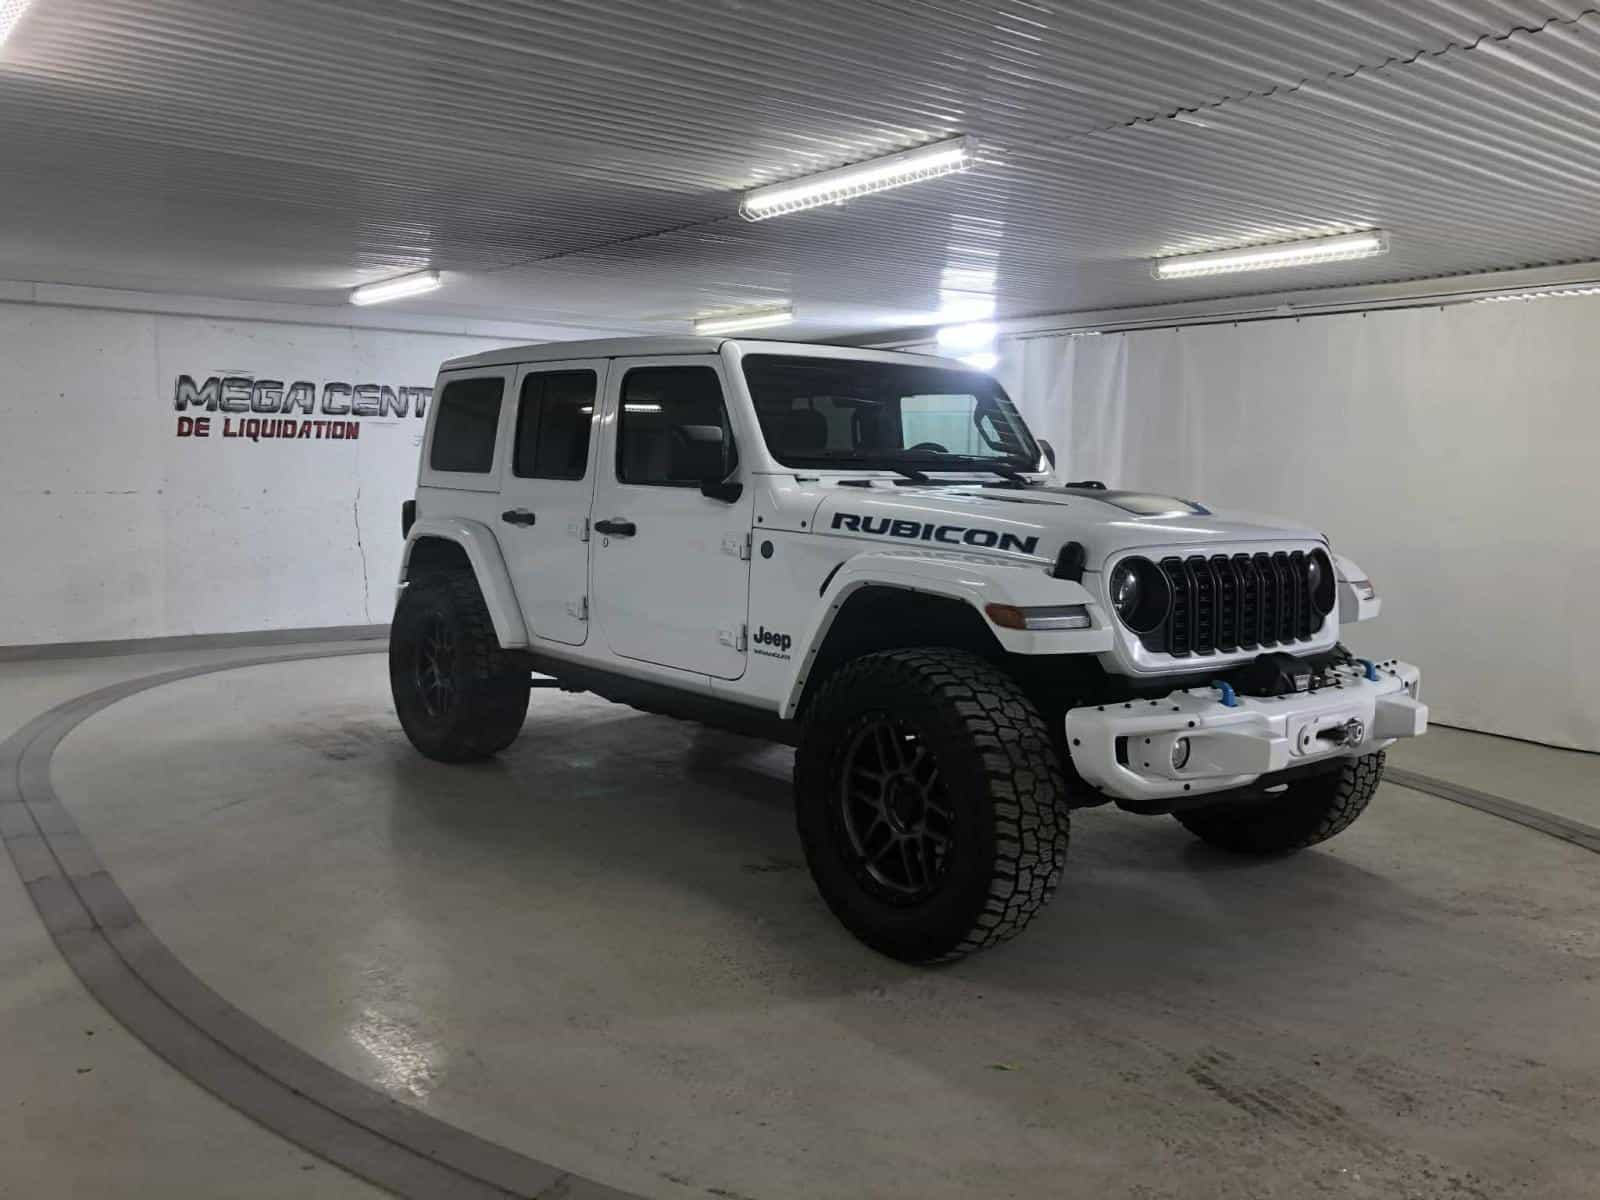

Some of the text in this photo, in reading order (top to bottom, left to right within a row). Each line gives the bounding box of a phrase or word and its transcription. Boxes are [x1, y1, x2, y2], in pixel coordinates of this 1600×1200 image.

[176, 416, 360, 442] DE LIQUIDATION
[831, 512, 1040, 555] RUBICON
[753, 626, 792, 652] Jeep
